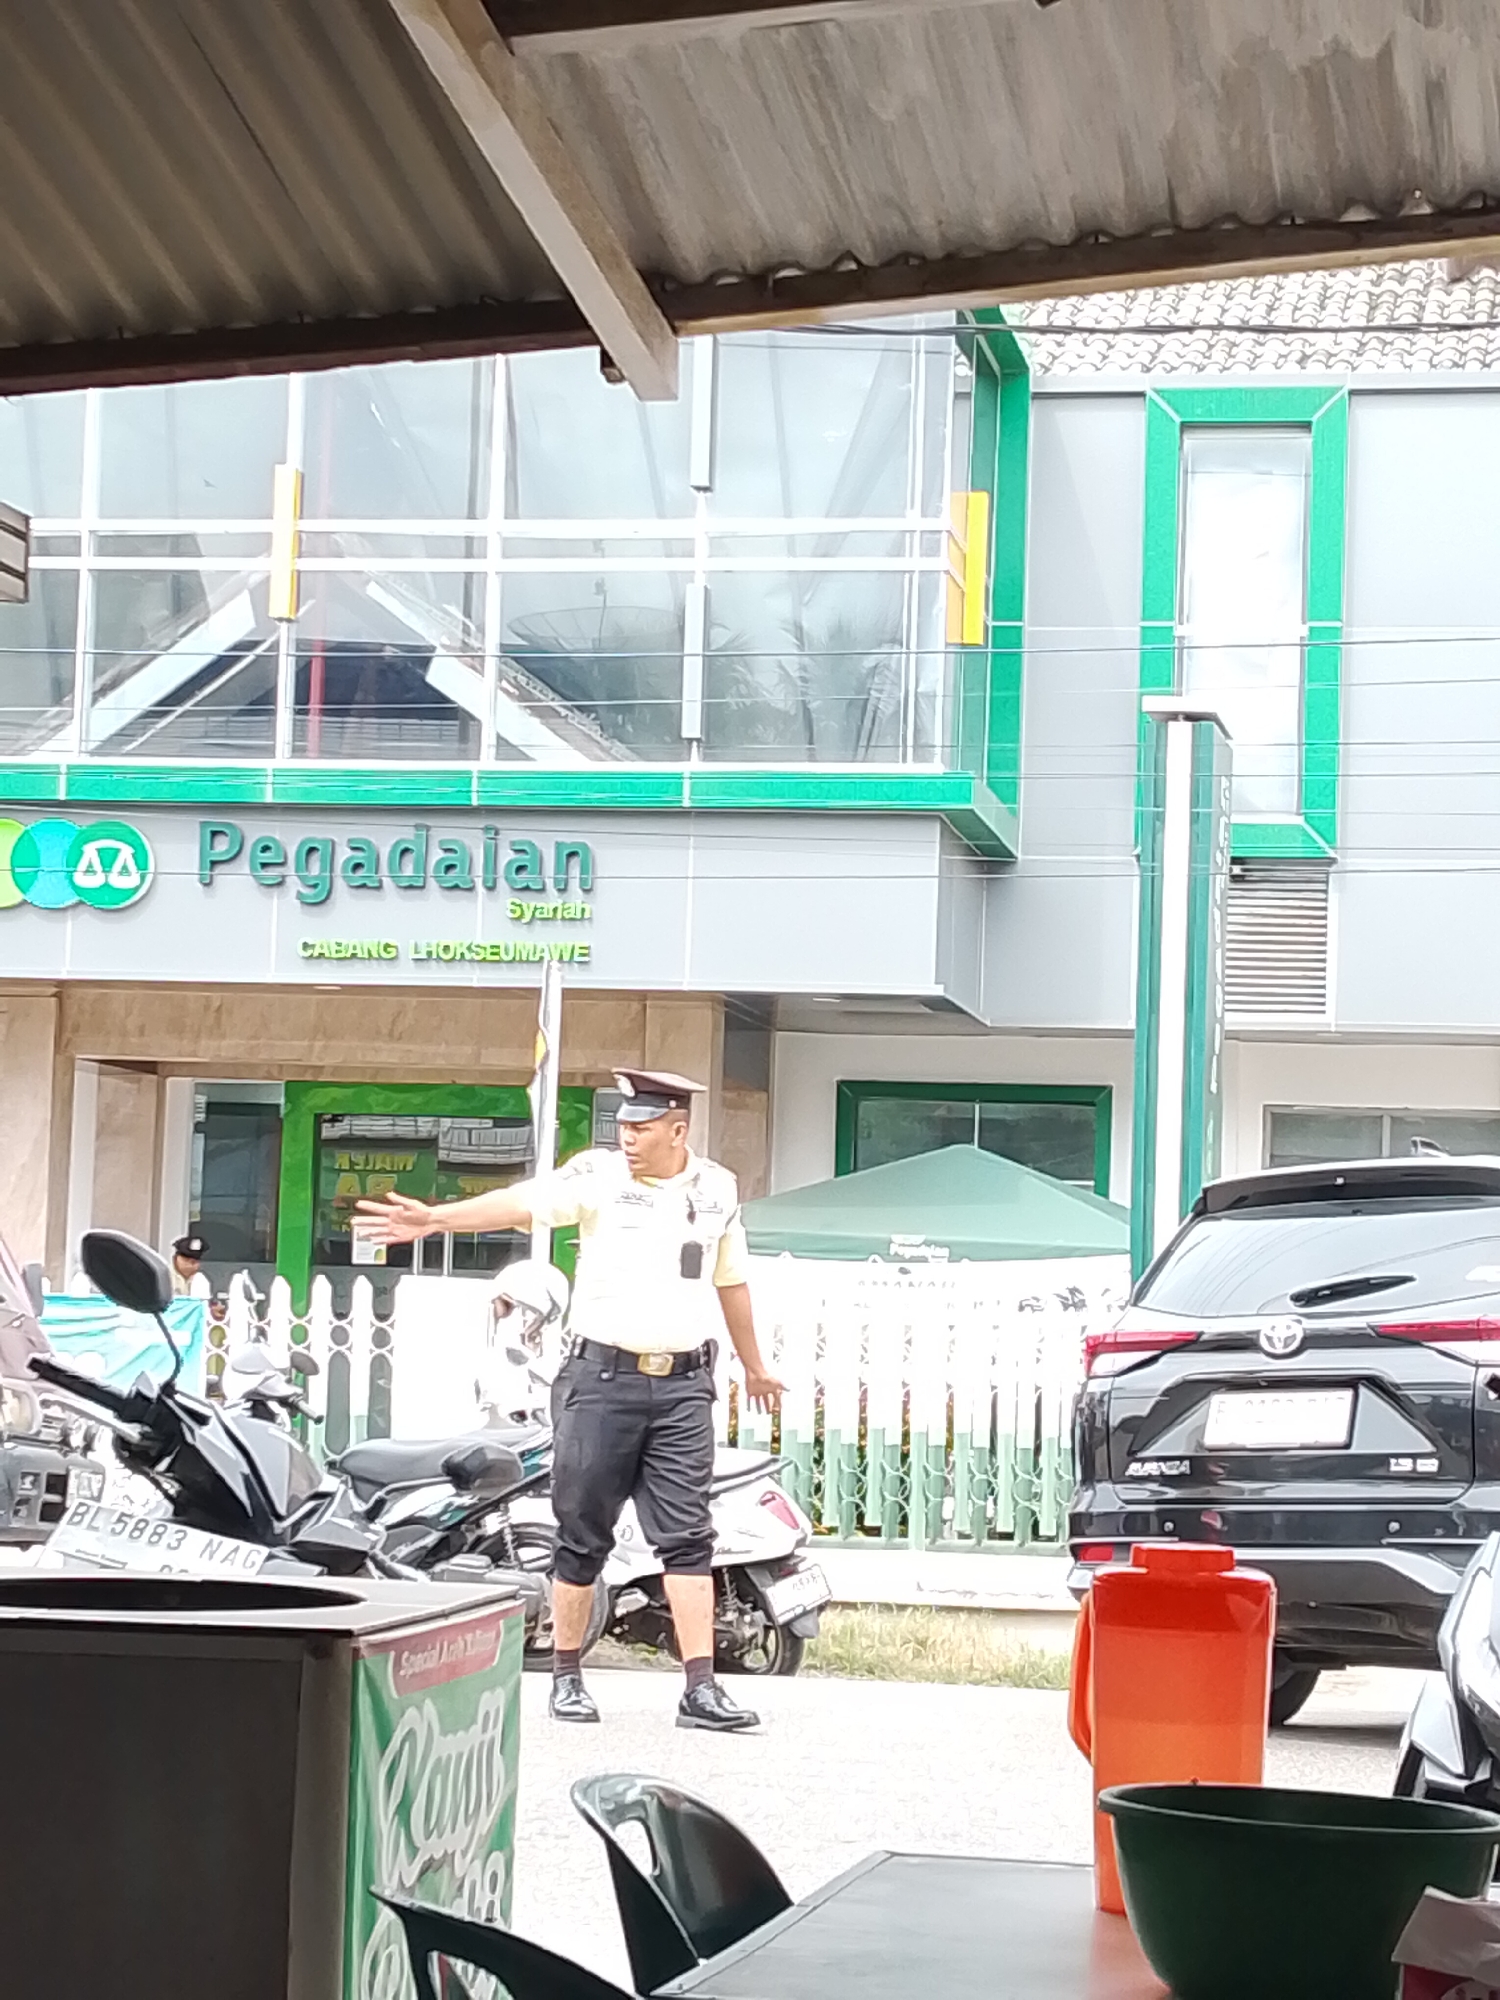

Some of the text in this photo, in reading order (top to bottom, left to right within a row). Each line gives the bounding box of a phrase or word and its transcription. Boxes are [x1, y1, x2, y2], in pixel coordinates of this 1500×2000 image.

[197, 820, 593, 904] Pegadaian
[505, 898, 592, 924] Syariah
[296, 938, 592, 963] CABANG LHOKSEUMAWE
[67, 1502, 101, 1531] BL
[110, 1512, 188, 1551] 5883
